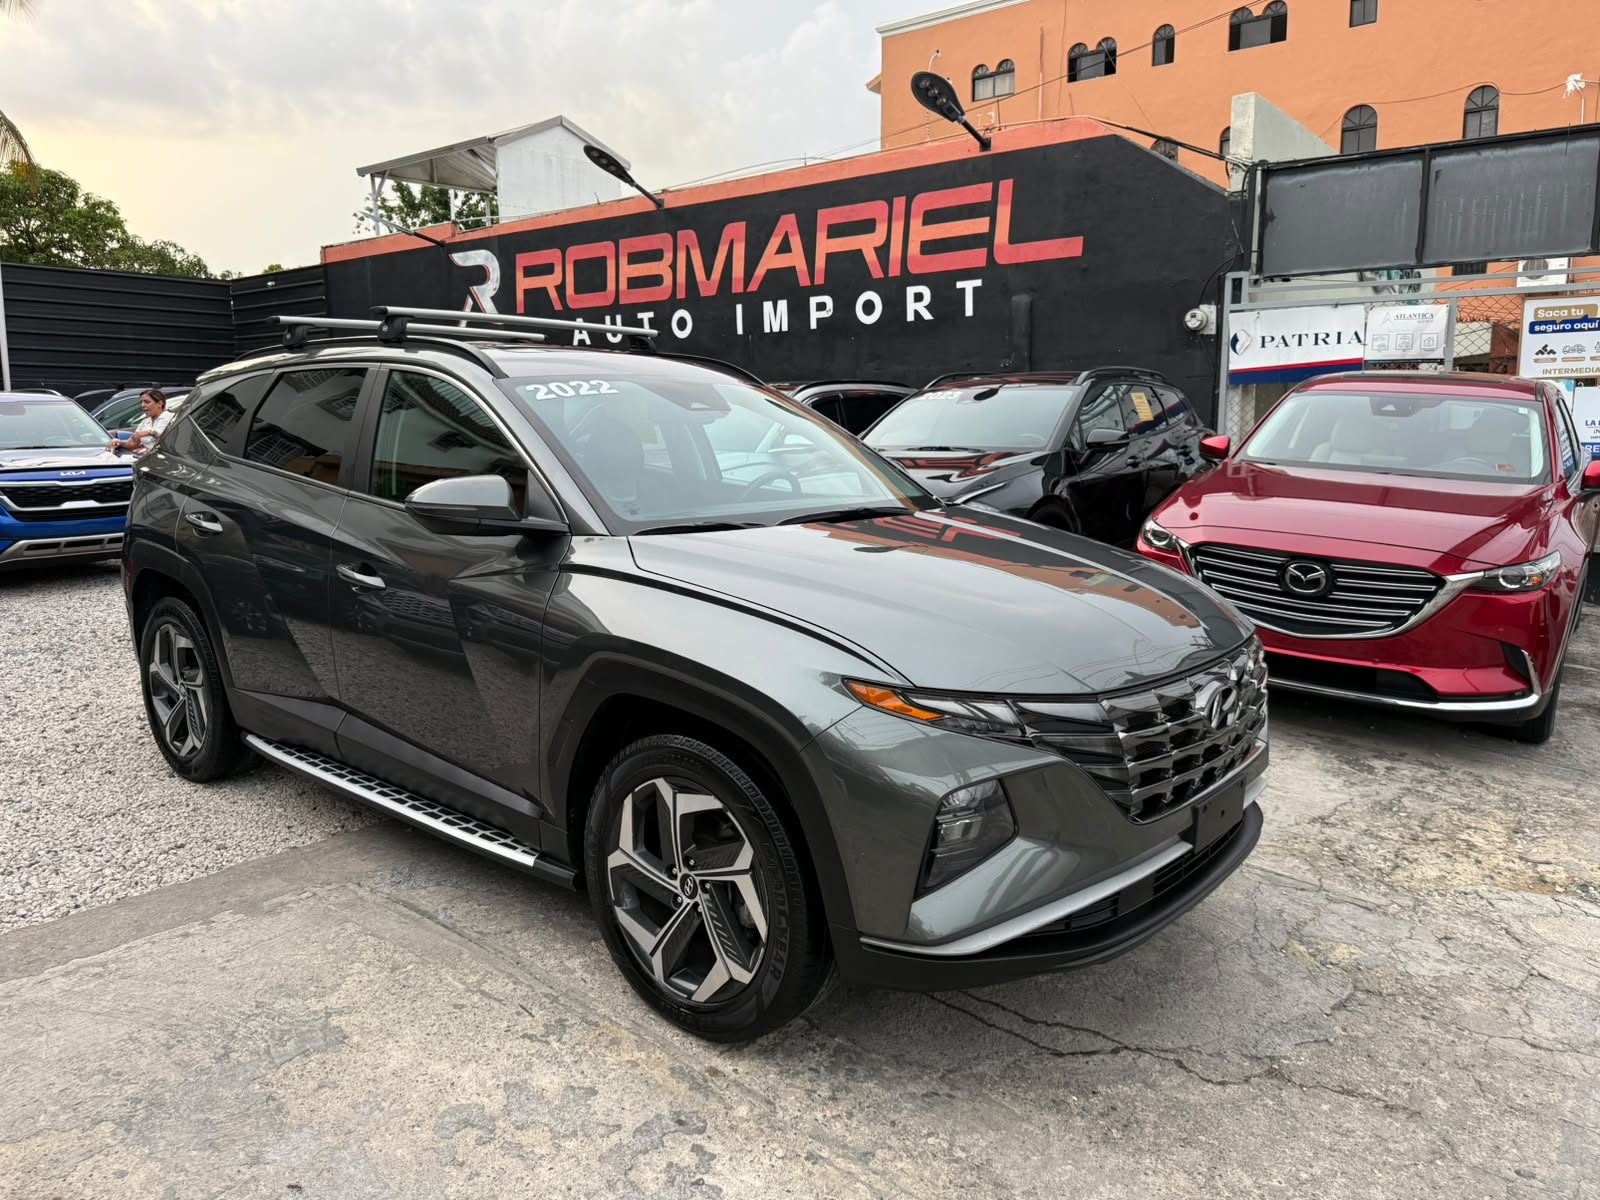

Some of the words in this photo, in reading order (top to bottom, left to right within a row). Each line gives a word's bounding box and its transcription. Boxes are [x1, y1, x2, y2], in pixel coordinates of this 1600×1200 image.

[516, 178, 1084, 314] ROBMARIEL
[573, 309, 693, 346] AUTO
[735, 279, 983, 335] IMPORT
[1537, 309, 1568, 318] Saca
[1571, 308, 1584, 316] tu
[1534, 323, 1572, 333] seguro
[1573, 320, 1599, 331] aquí
[1260, 330, 1364, 348] PATRIA
[526, 380, 620, 400] 2022
